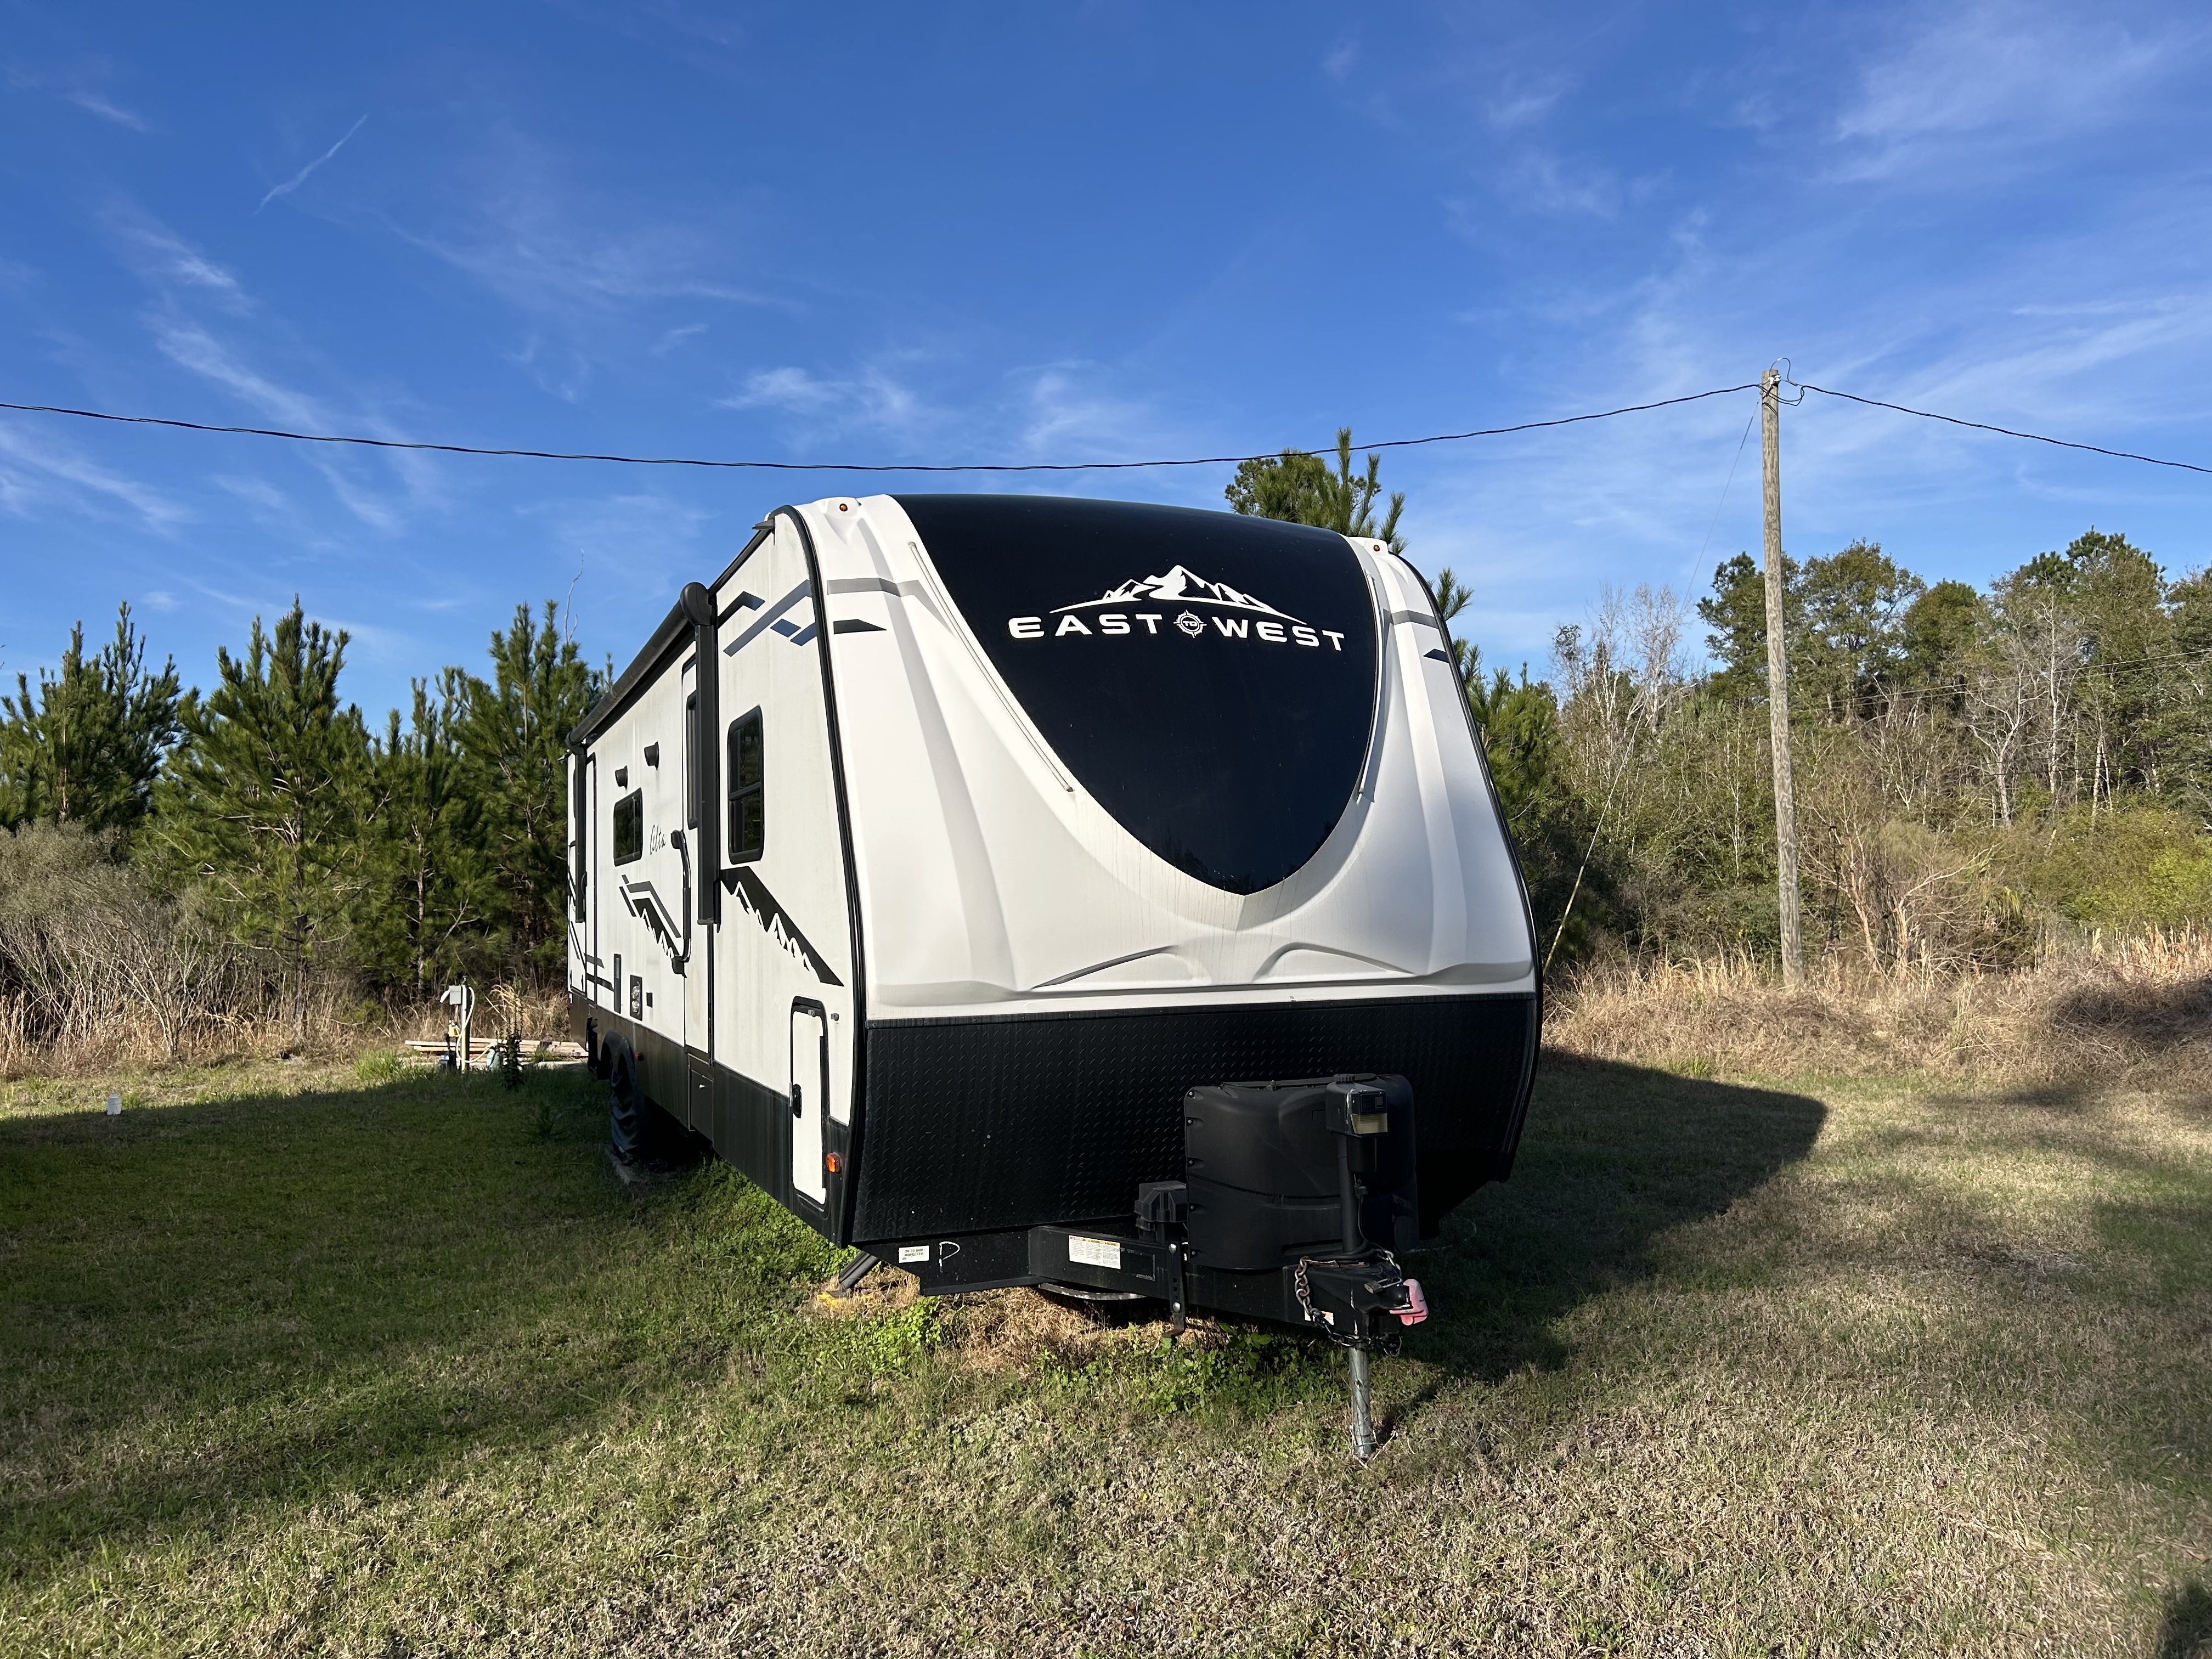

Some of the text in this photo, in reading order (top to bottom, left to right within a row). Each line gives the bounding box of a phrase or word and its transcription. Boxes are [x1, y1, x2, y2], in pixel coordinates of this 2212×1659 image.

[1008, 613, 1163, 639] EAST
[1211, 616, 1345, 651] WEST
[650, 824, 666, 855] Alta
[939, 1241, 960, 1273] P
